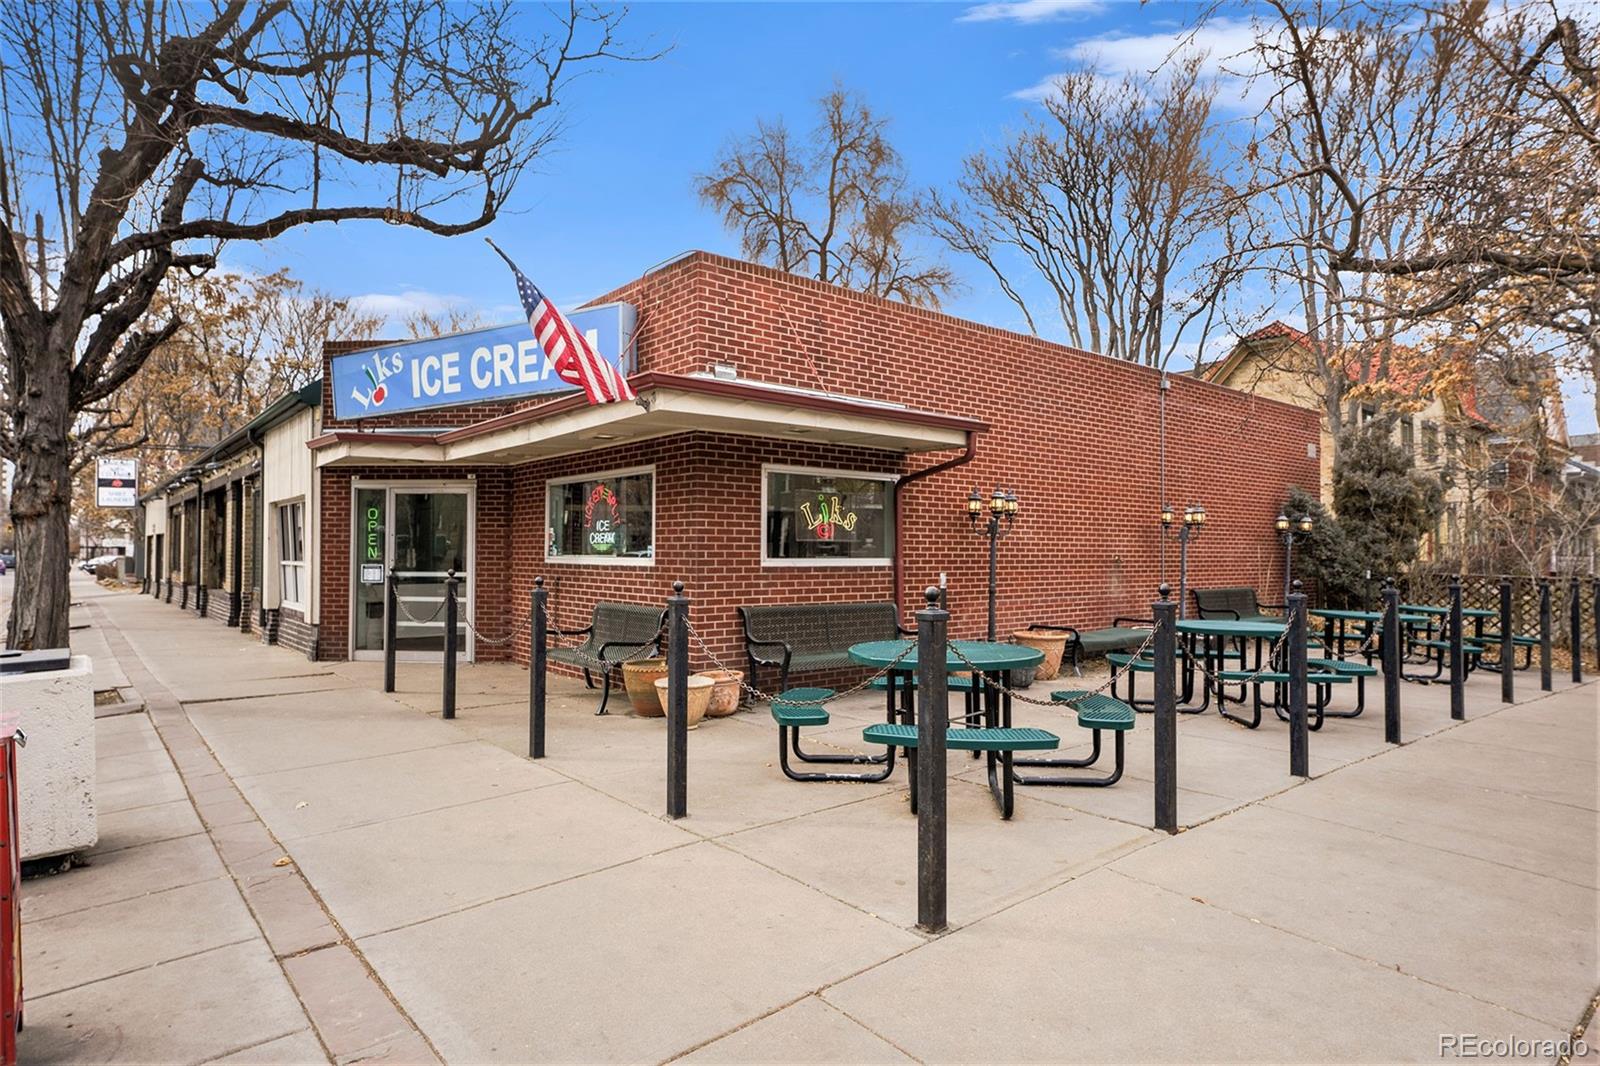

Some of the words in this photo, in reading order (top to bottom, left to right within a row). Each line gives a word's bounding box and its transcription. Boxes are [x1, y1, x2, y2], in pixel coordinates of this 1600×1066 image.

[350, 352, 404, 411] Liks
[411, 352, 462, 398] ICE
[596, 520, 610, 532] ICE
[800, 494, 858, 532] Liks
[367, 507, 378, 560] OPEN
[589, 532, 615, 544] CREAM
